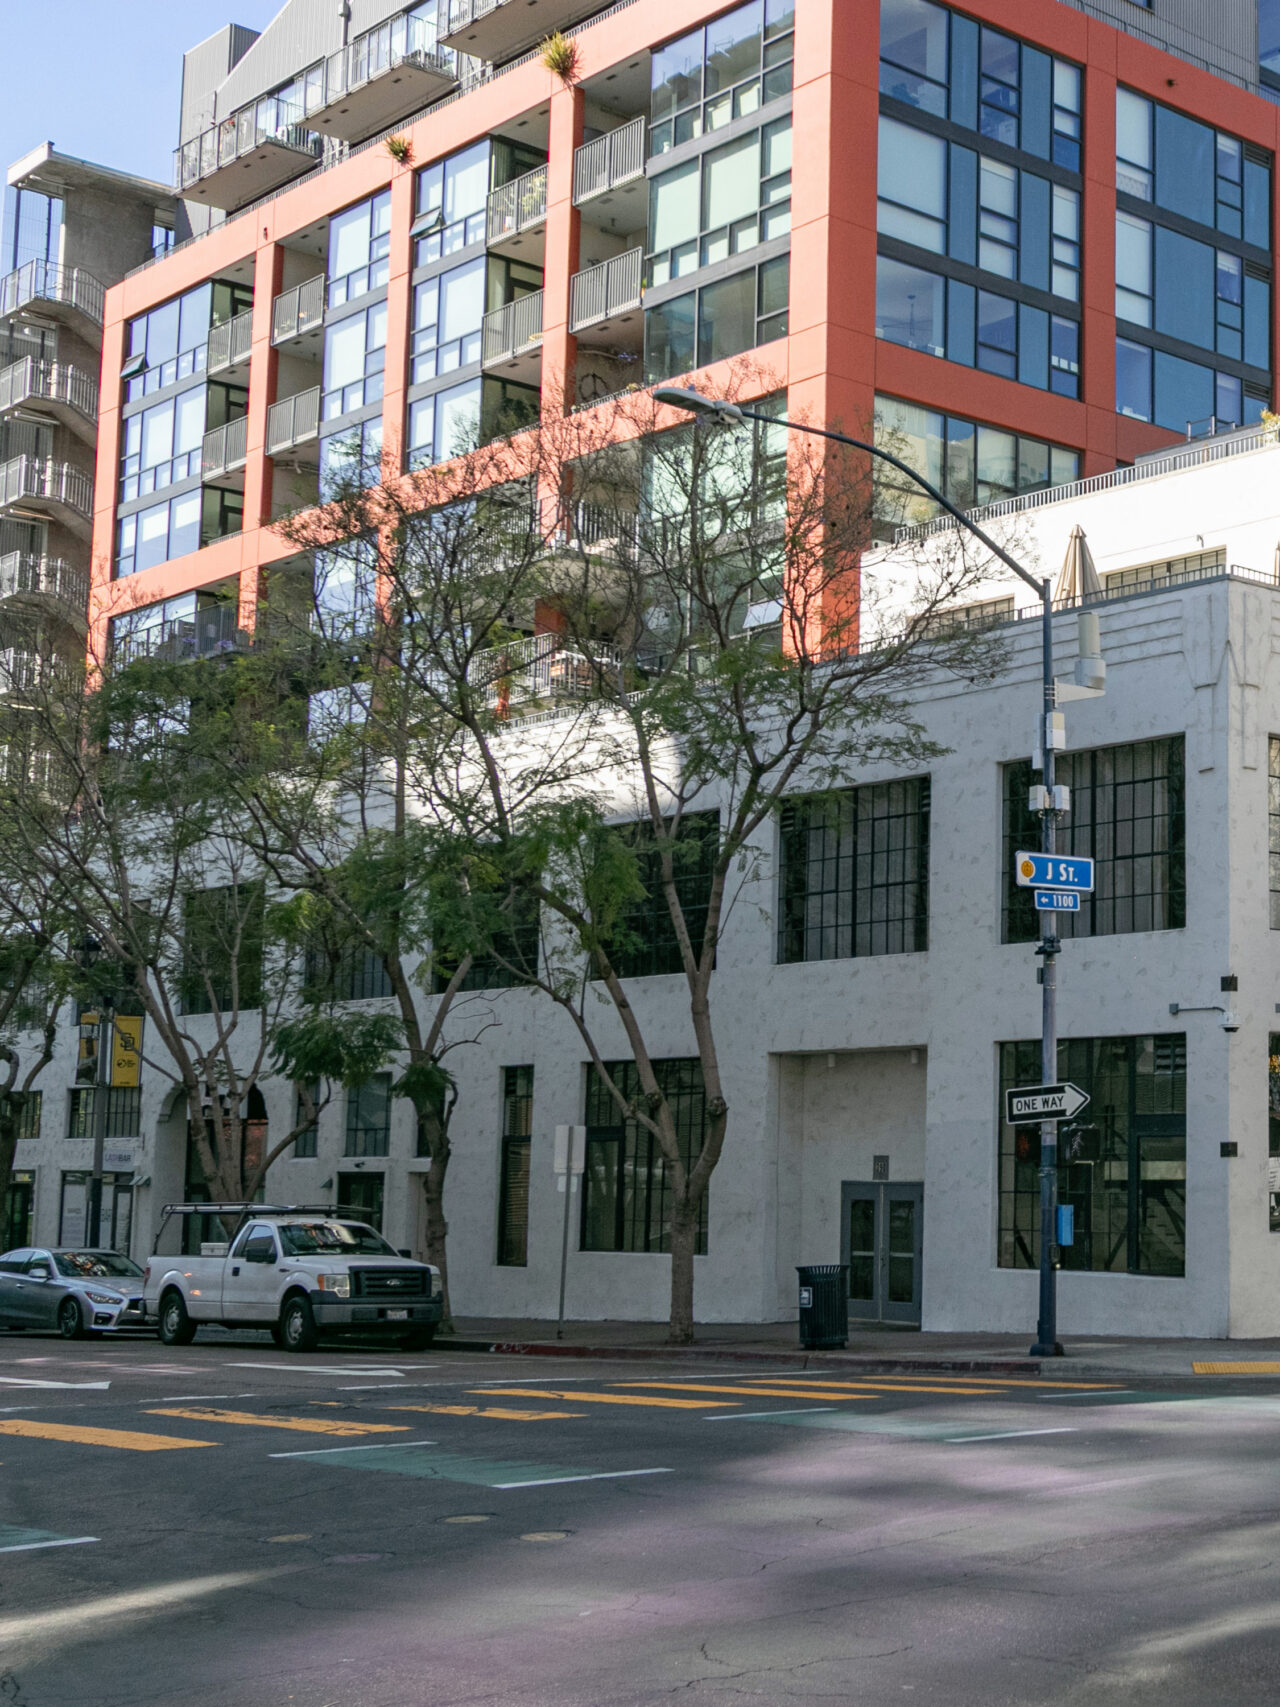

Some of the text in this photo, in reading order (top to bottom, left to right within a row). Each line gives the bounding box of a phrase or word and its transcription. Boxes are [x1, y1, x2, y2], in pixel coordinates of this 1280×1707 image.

[1046, 862, 1053, 880] J
[1053, 894, 1074, 907] 1100
[1016, 1095, 1064, 1112] ONE WAY
